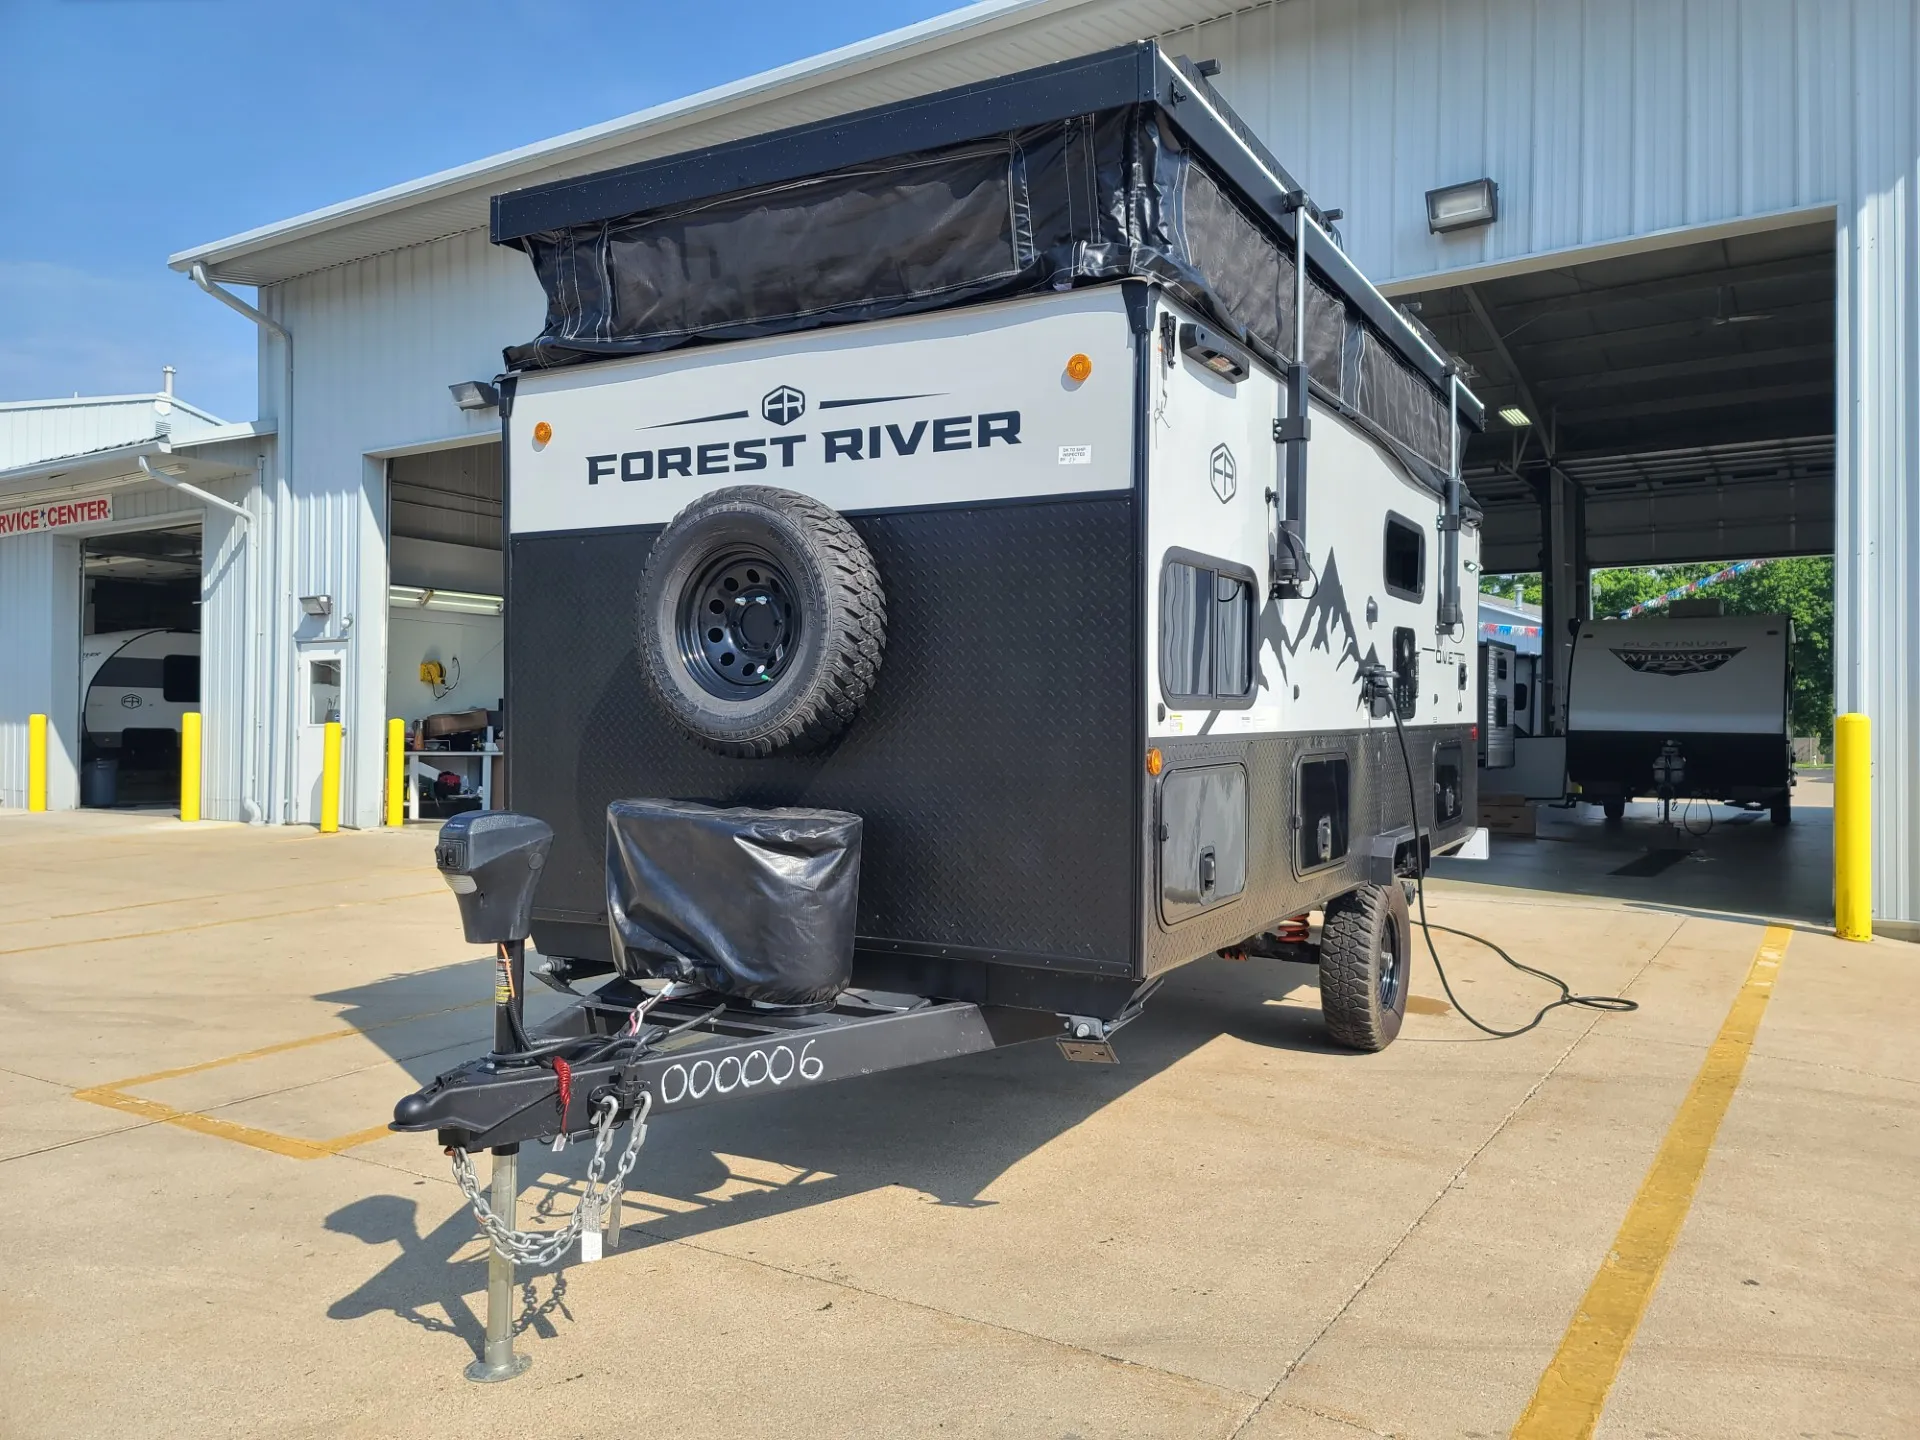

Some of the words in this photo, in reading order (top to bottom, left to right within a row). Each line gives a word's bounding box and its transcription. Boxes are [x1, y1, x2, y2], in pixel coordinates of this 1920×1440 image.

[585, 434, 806, 485] FOREST
[821, 410, 1022, 463] RIVER
[47, 499, 109, 527] CENTER
[1622, 640, 1728, 648] PLATINUM
[1620, 652, 1732, 662] WILDWOOD
[1640, 661, 1714, 671] FSX
[661, 1039, 824, 1104] 000006
